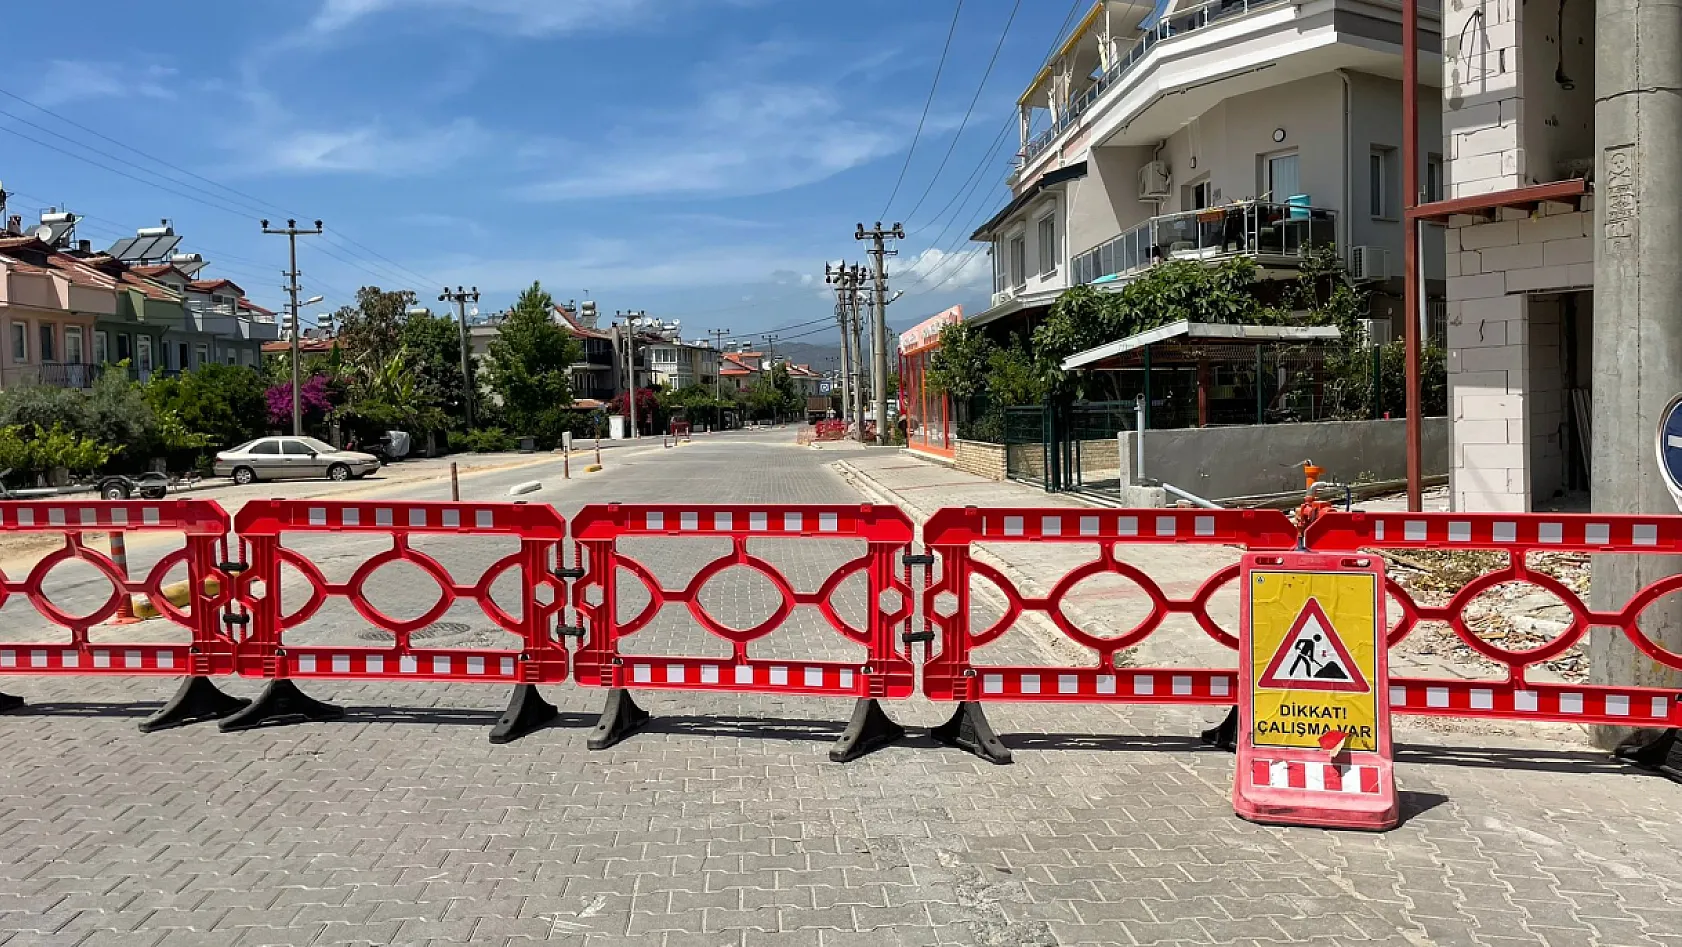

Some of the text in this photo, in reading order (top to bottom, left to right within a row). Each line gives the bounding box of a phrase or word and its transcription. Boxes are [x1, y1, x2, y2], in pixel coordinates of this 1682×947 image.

[1279, 702, 1347, 720] DİKKAT!
[1257, 720, 1372, 738] ÇALIŞMA VAR
